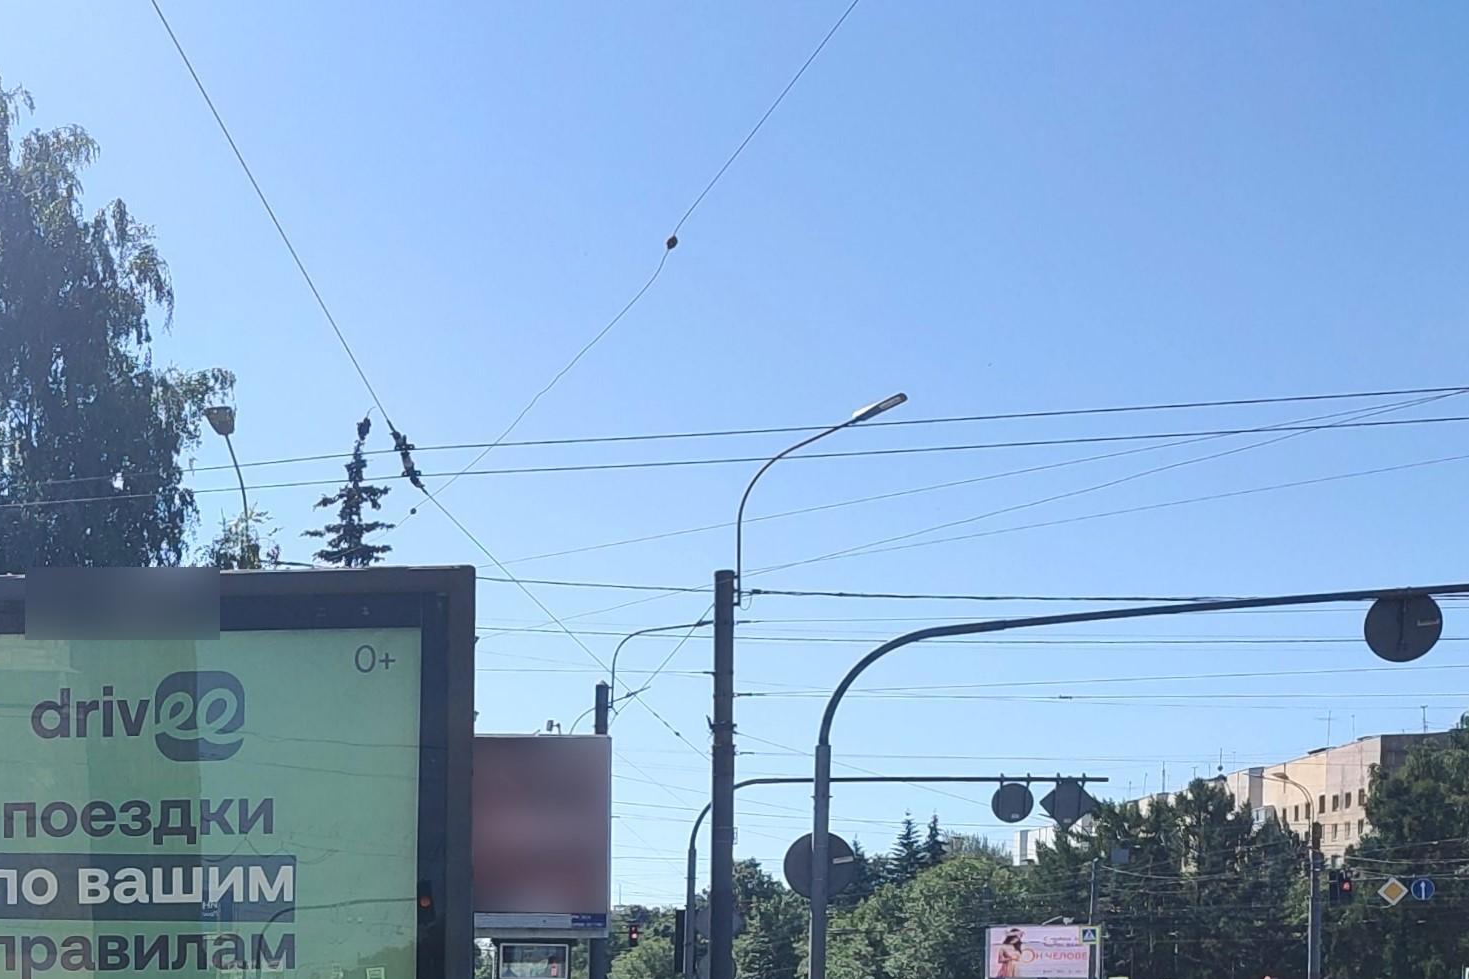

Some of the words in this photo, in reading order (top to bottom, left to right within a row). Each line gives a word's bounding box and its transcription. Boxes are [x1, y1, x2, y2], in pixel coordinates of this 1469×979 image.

[354, 644, 397, 674] 0+
[31, 670, 246, 761] drivee
[3, 797, 275, 846] поездки
[78, 863, 294, 905] вашим
